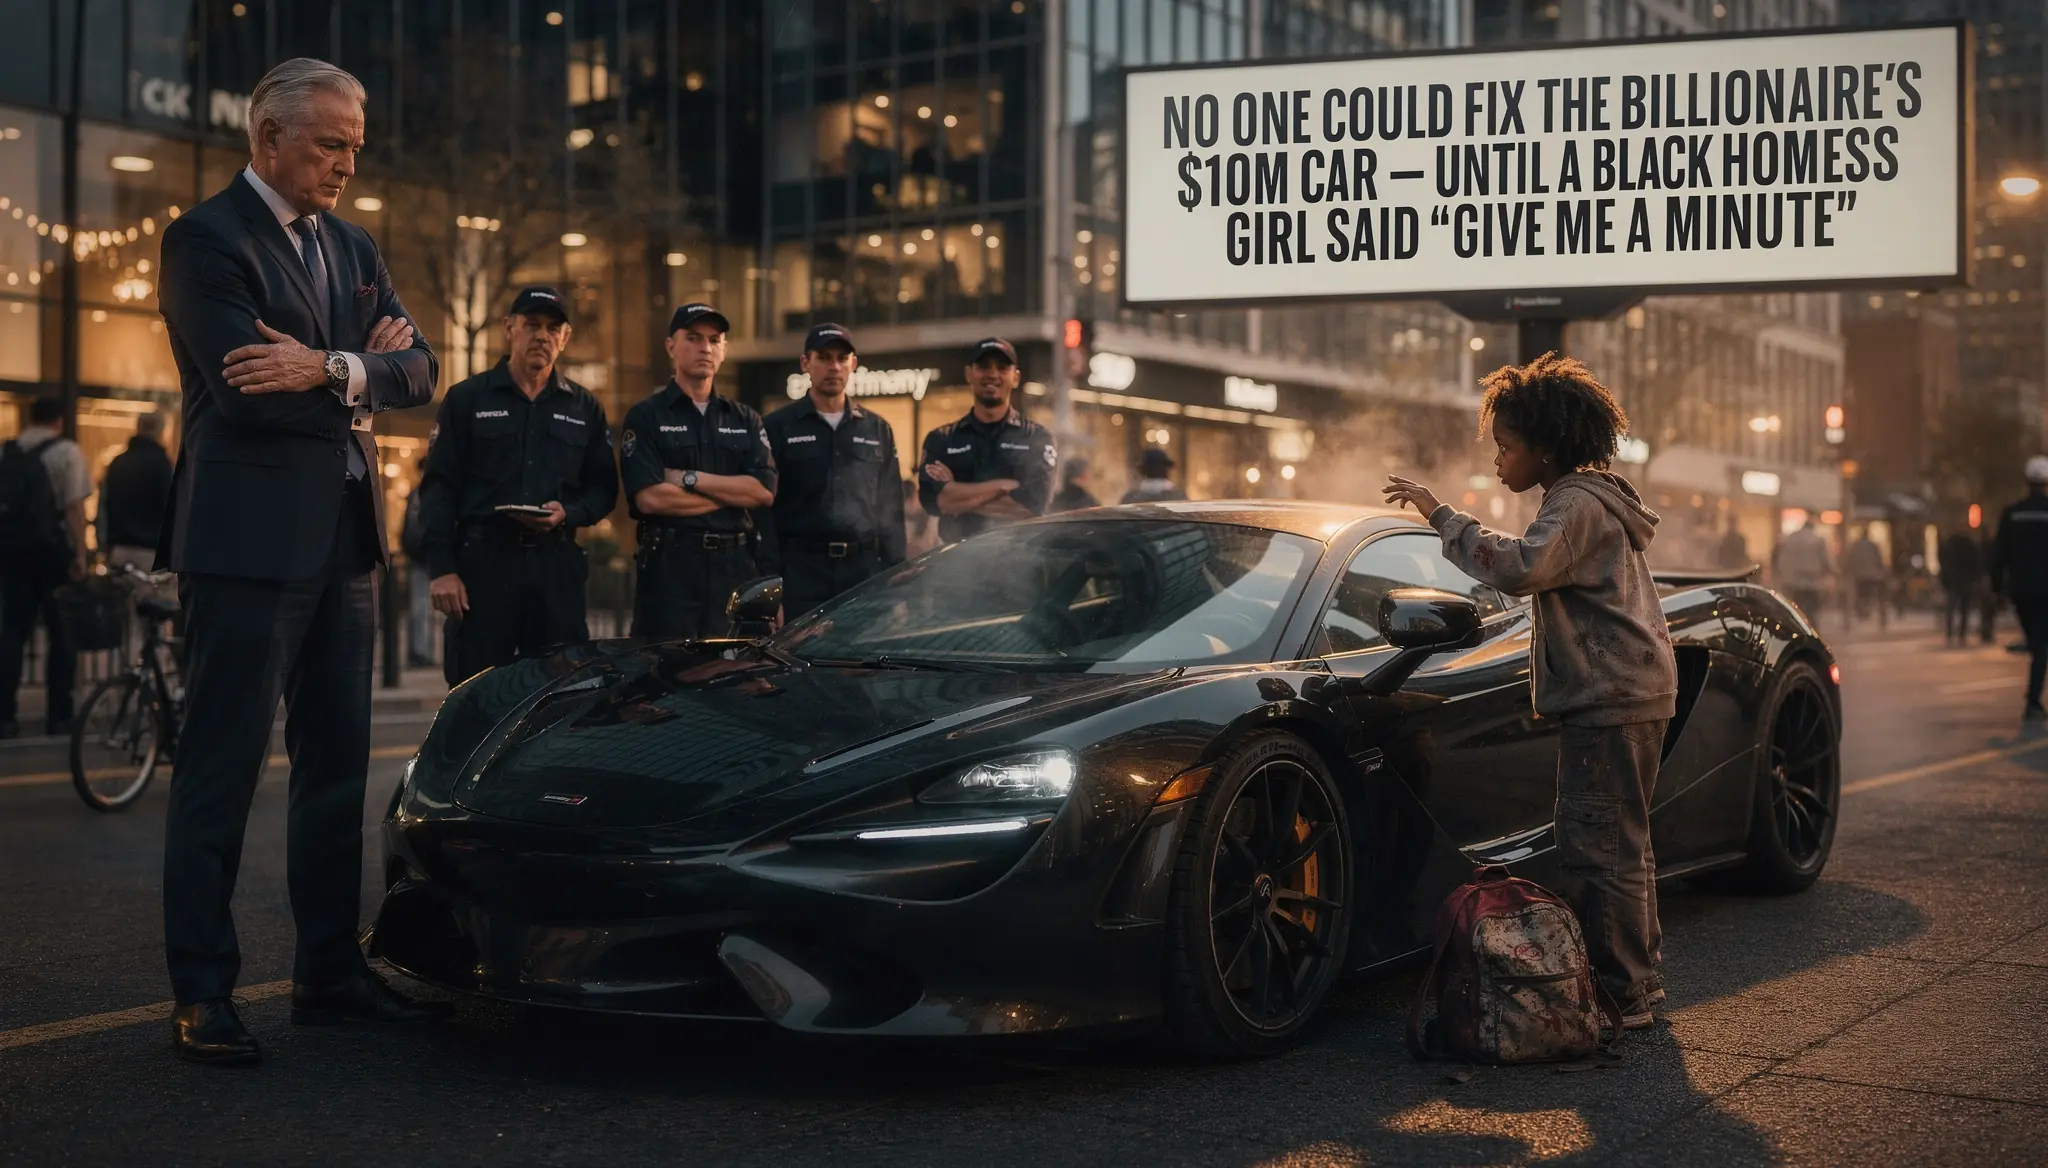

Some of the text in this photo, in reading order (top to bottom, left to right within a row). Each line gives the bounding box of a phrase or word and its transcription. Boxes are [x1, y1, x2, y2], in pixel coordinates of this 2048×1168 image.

[1163, 93, 1219, 149] NO
[1232, 89, 1312, 147] ONE
[1322, 81, 1453, 143] COULD
[1465, 80, 1526, 136] FIX
[1537, 76, 1611, 134] THE
[1177, 151, 1288, 213] $10M
[1301, 148, 1378, 204] CAR
[1436, 141, 1550, 198] UNTIL
[1557, 139, 1582, 193] A
[1593, 134, 1718, 192] BLACK
[1722, 125, 1899, 187] HOMESS
[1226, 190, 1858, 267] GIRL SAID “GIVE ME A MINUTE”
